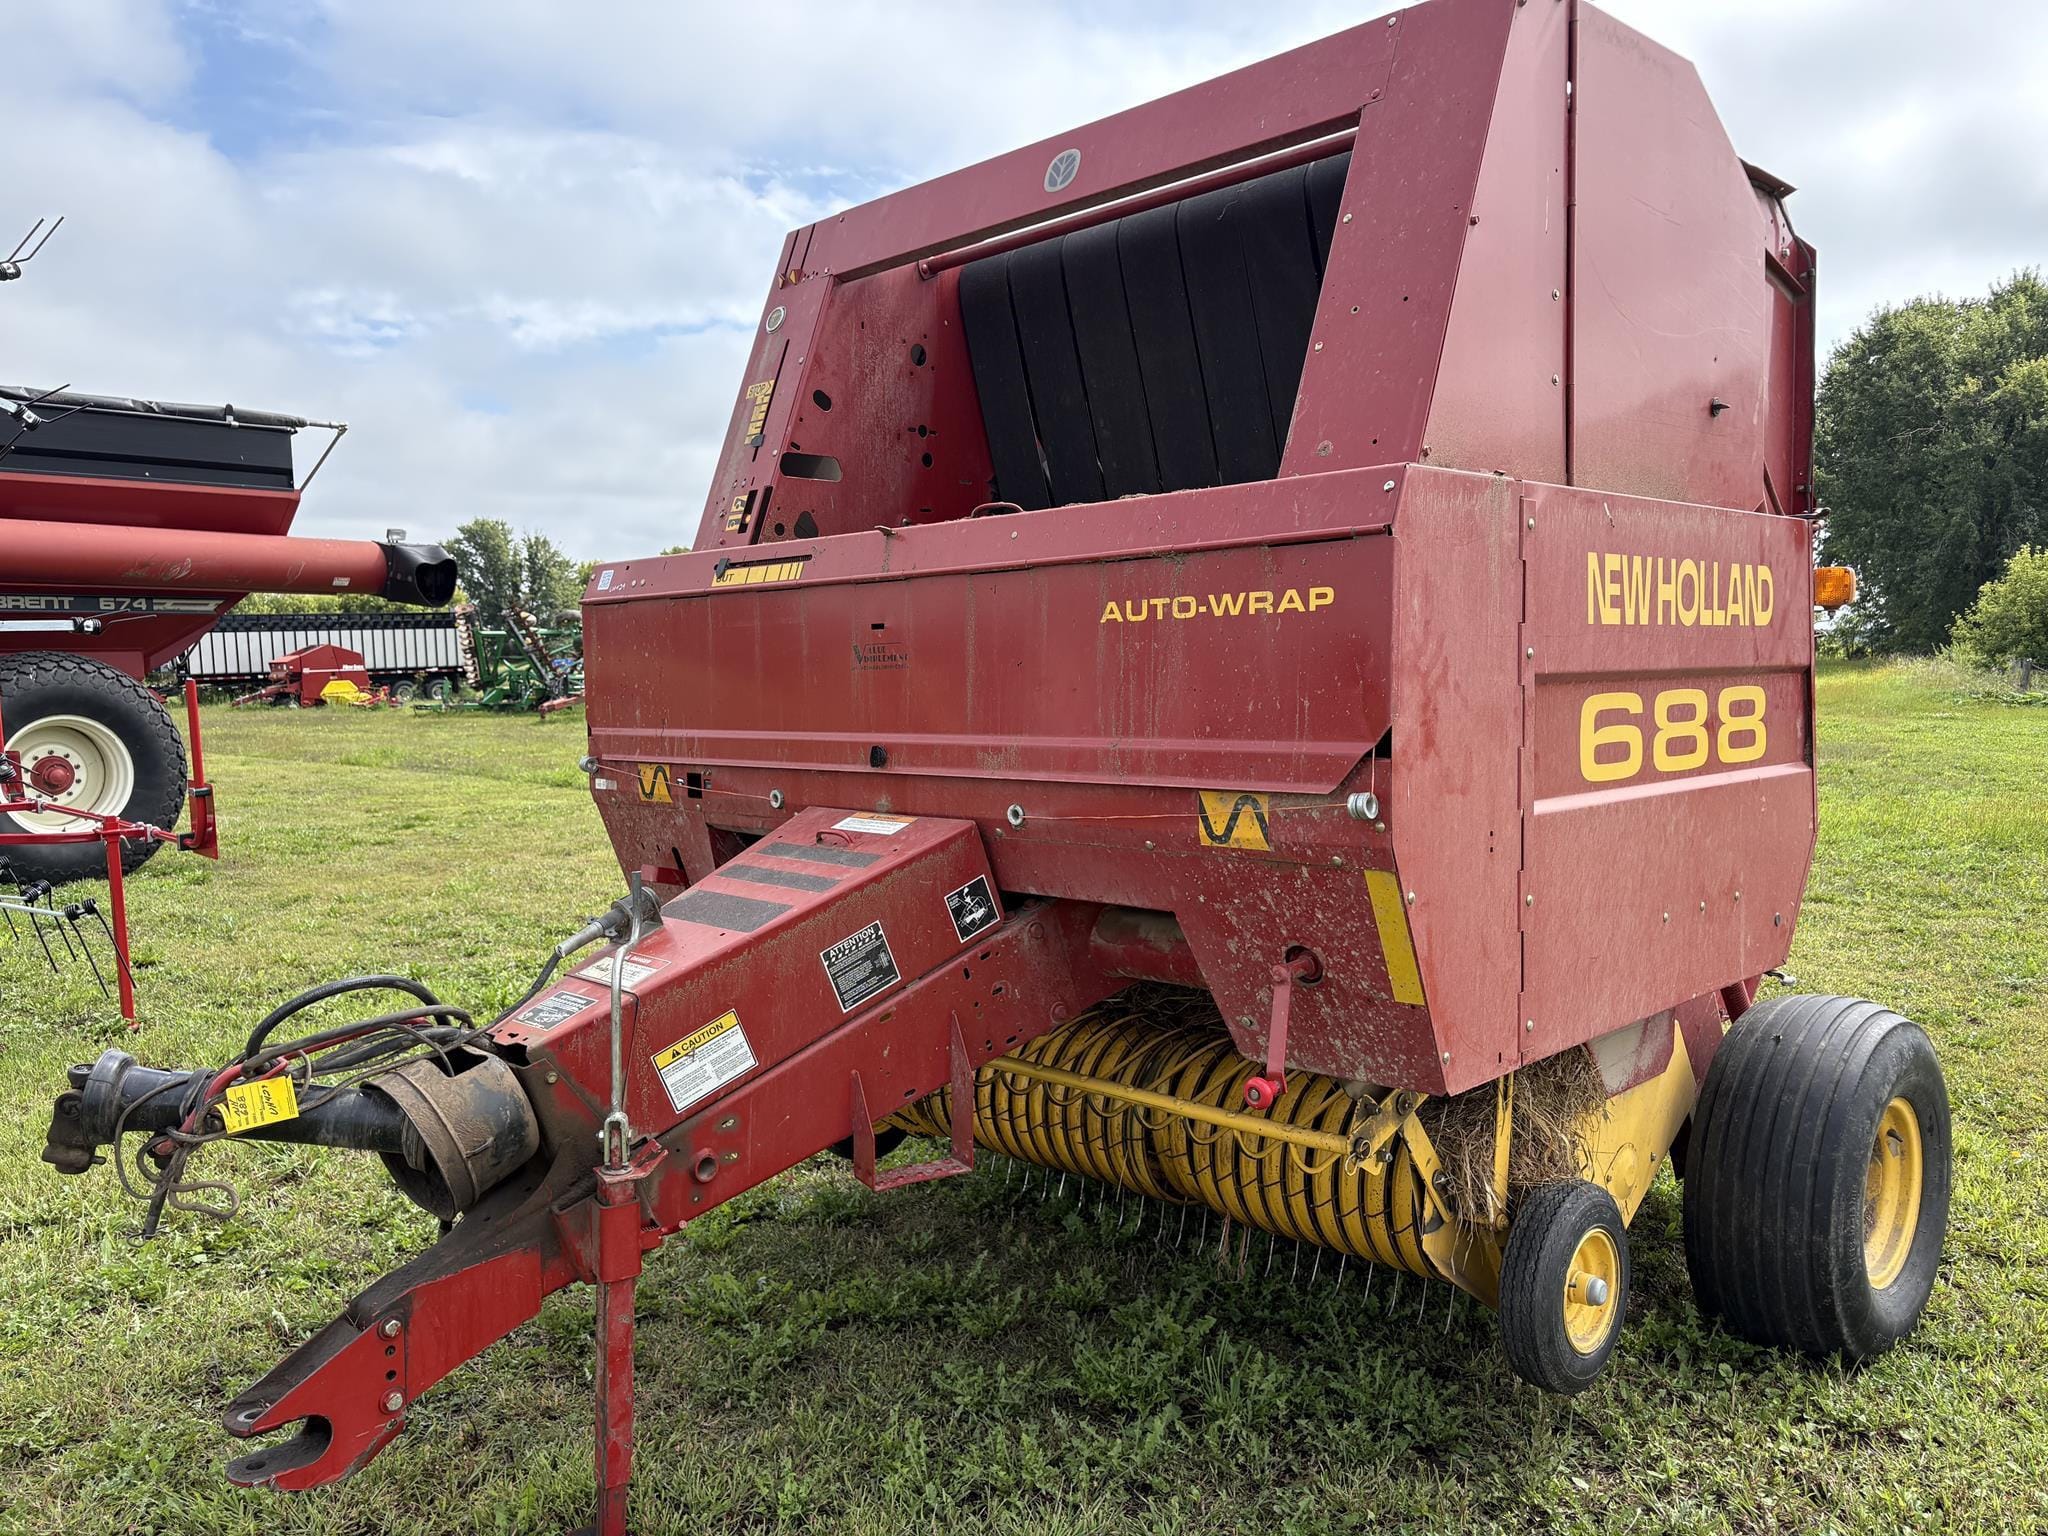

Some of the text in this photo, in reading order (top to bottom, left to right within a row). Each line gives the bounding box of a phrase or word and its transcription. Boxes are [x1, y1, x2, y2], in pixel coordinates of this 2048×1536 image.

[748, 383, 767, 397] STOP
[99, 597, 147, 611] 674
[1100, 586, 1336, 624] AUTO-WRAP
[1587, 551, 1775, 627] NEW HOLLAND
[1579, 685, 1767, 783] 688
[829, 926, 875, 959] ATTENTION
[681, 1021, 725, 1052] CAUTION
